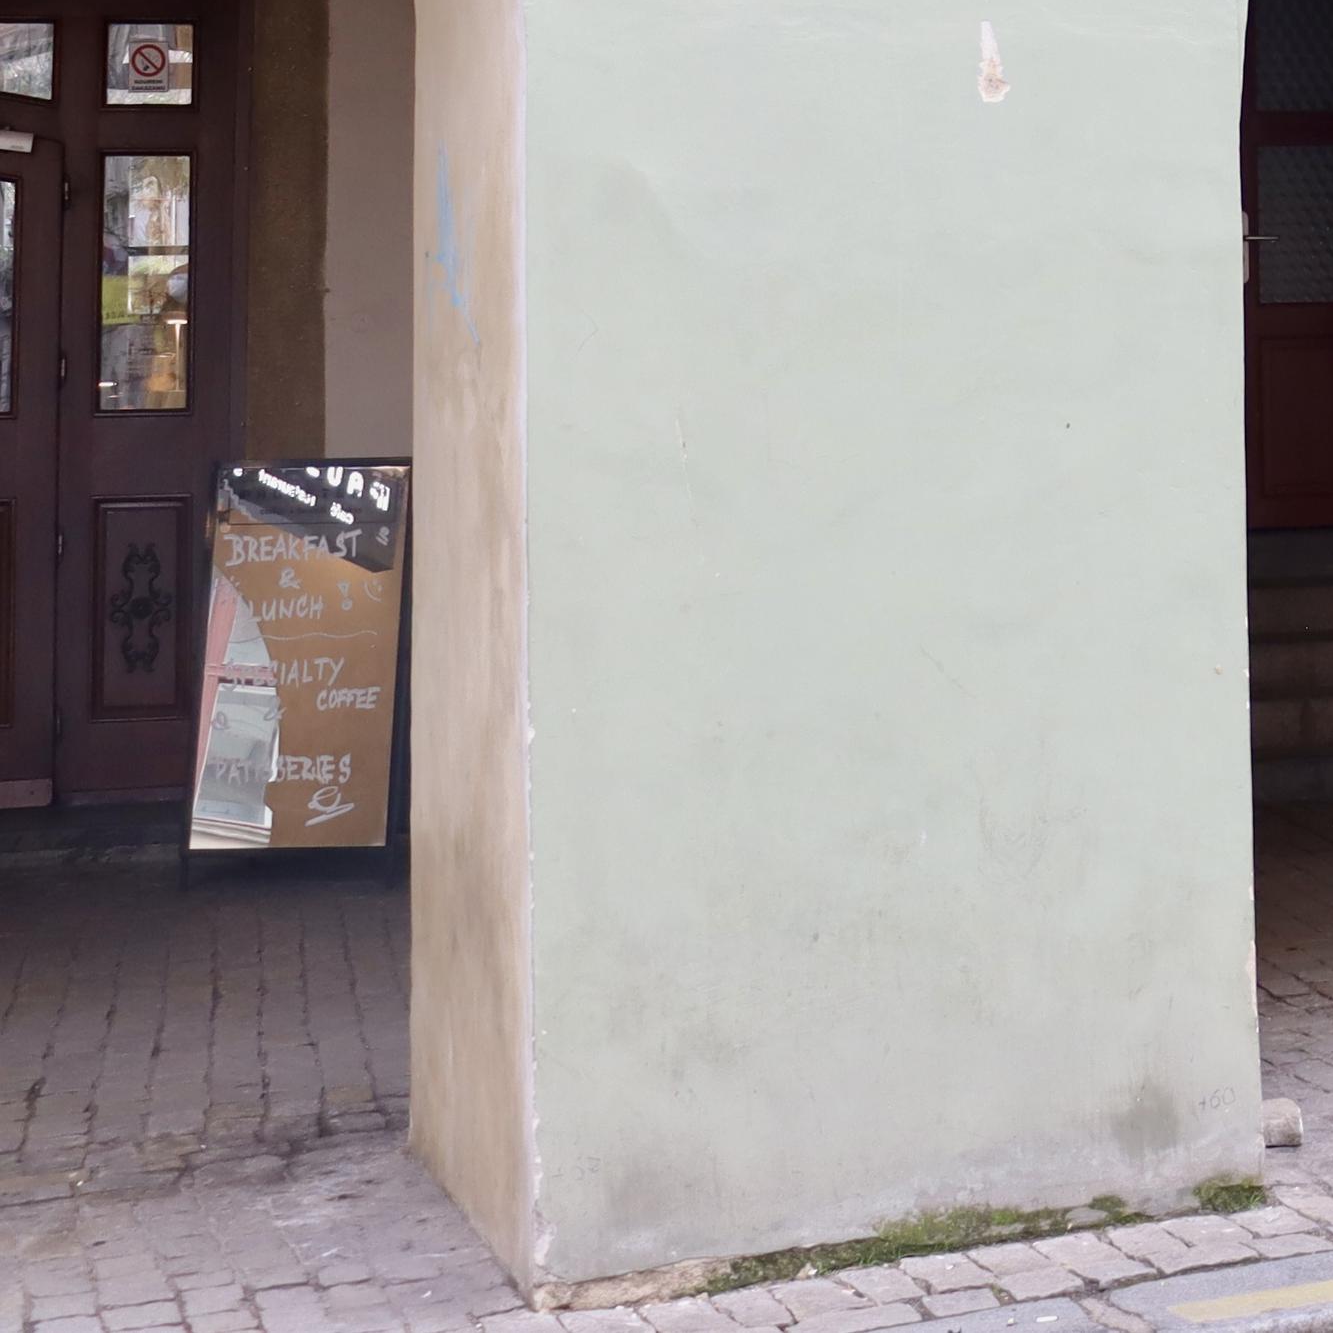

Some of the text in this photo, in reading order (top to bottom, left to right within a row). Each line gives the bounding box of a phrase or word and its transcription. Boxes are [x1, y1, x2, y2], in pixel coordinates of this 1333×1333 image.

[223, 529, 362, 567] BREAKFAST
[278, 566, 300, 590] &
[247, 593, 323, 622] LUNCH
[316, 686, 381, 711] COFFEE
